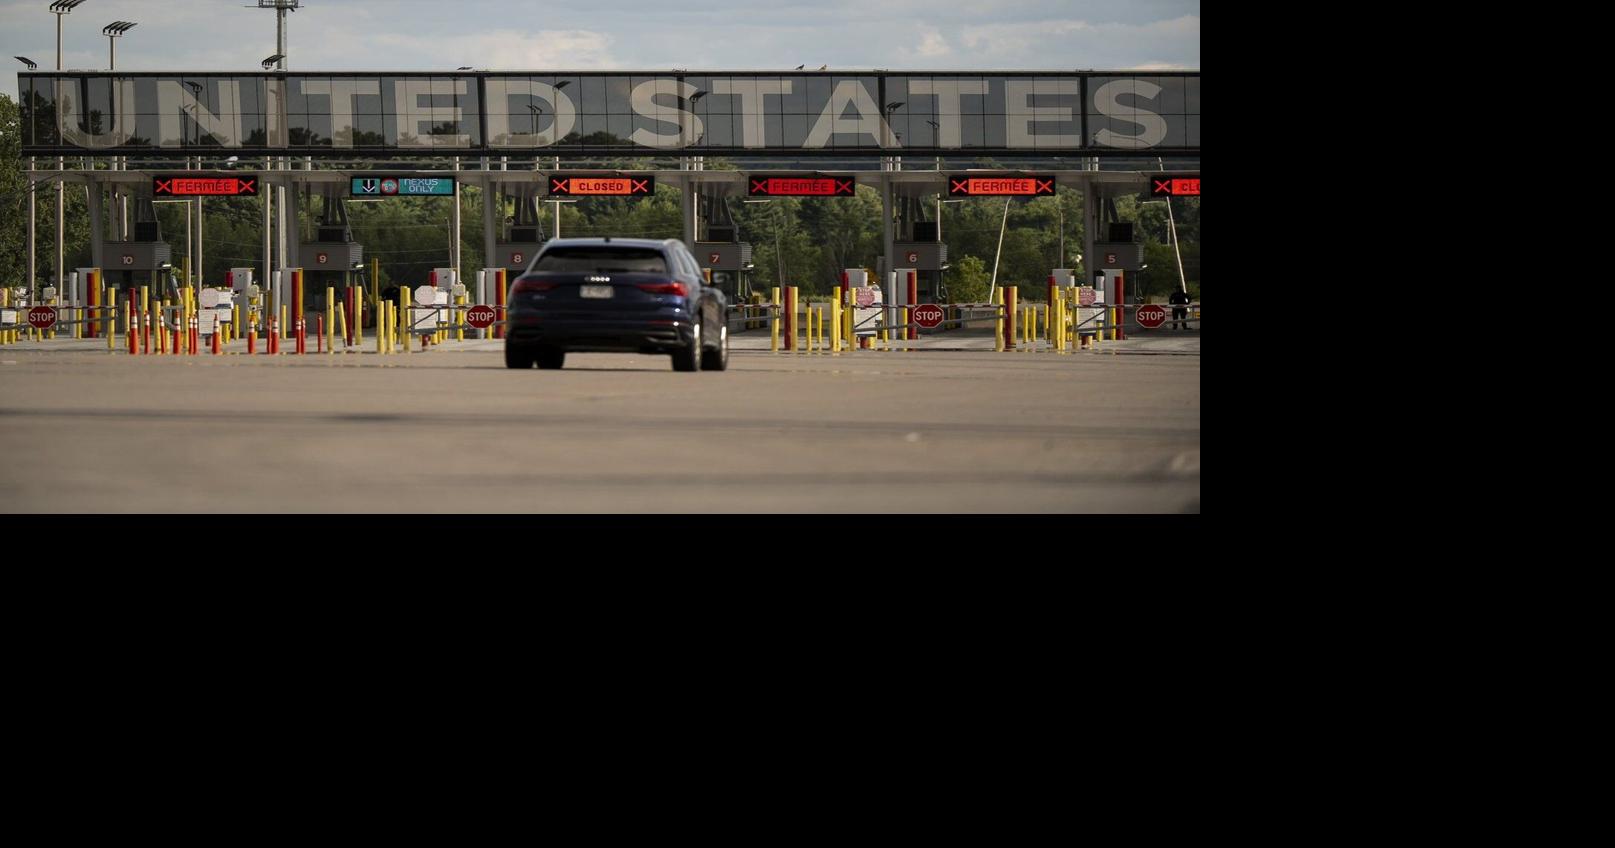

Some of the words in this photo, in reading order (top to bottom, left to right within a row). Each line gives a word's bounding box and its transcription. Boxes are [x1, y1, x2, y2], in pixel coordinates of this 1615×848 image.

[54, 79, 576, 149] UNITED
[628, 79, 1168, 149] STATES
[176, 179, 232, 192] FERMÉE
[578, 182, 624, 191] CLOSED
[973, 179, 1029, 192] FERMÉE
[123, 256, 133, 264] 10
[319, 255, 327, 263] 9
[513, 254, 522, 263] 8
[711, 254, 719, 263] 7
[909, 254, 917, 262] 6
[1108, 254, 1116, 263] 5
[30, 312, 54, 322] STOP
[468, 311, 494, 321] STOP
[915, 310, 942, 321] STOP
[1138, 310, 1164, 321] STOP
